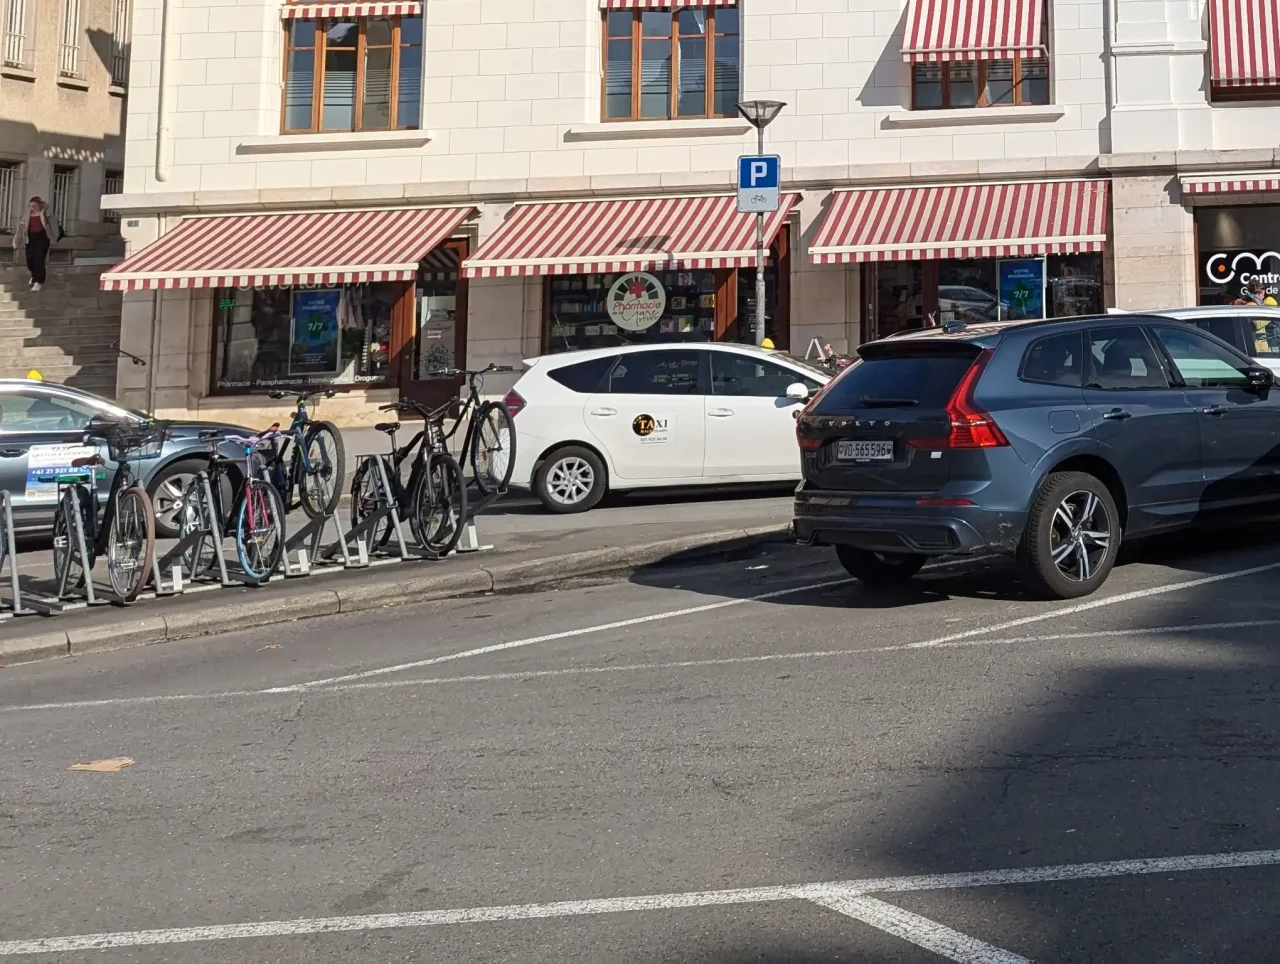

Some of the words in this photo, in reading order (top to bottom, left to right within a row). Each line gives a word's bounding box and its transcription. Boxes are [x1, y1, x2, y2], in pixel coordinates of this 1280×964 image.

[751, 161, 768, 186] P
[1013, 290, 1029, 298] 7/7
[1265, 285, 1279, 295] de
[613, 301, 661, 311] Pharmacie
[307, 322, 324, 331] 7/7
[217, 380, 251, 388] Pharmacie
[256, 377, 303, 386] Parapharmacie
[354, 373, 386, 383] Droguerie
[639, 419, 668, 430] TAXI
